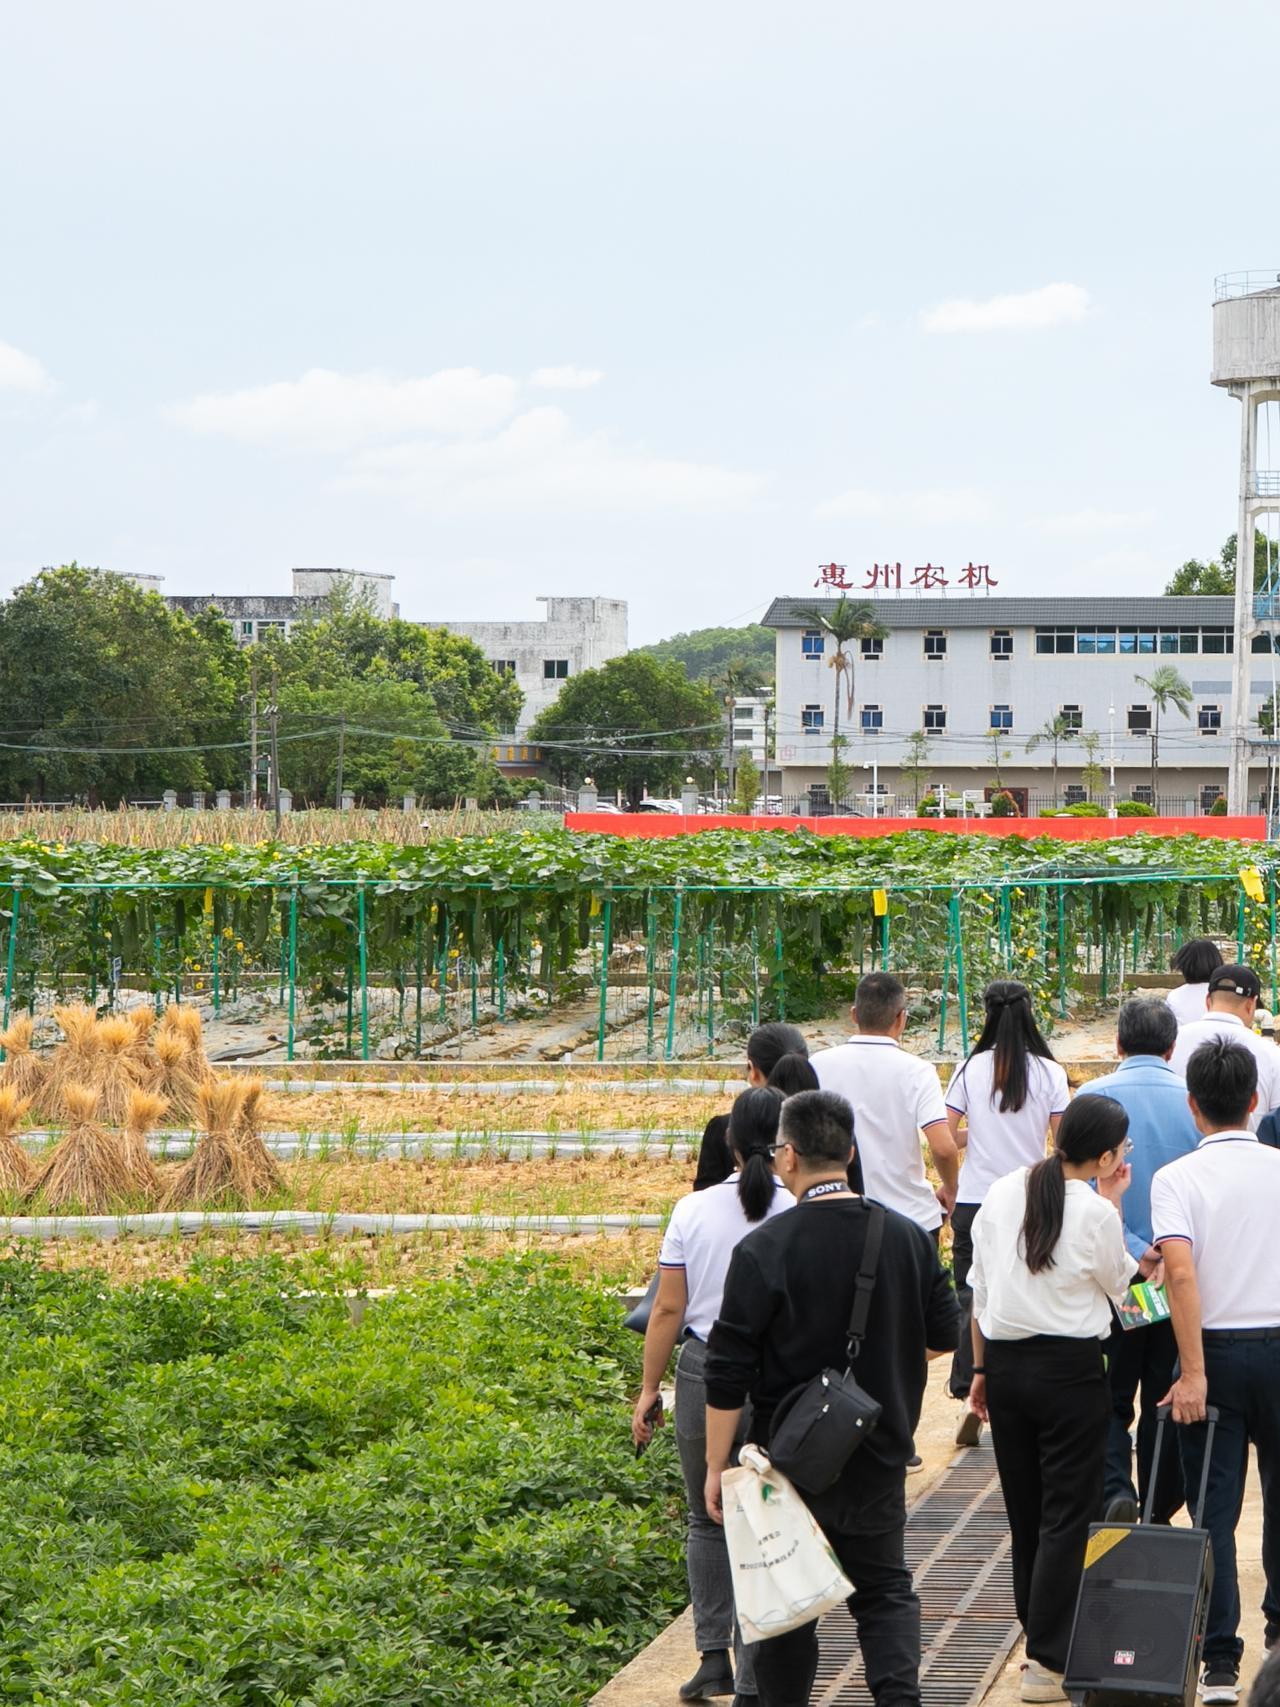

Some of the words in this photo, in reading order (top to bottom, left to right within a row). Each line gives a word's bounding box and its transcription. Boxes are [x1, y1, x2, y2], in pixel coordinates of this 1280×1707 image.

[813, 562, 999, 590] 惠州农机
[807, 1182, 842, 1198] SONY
